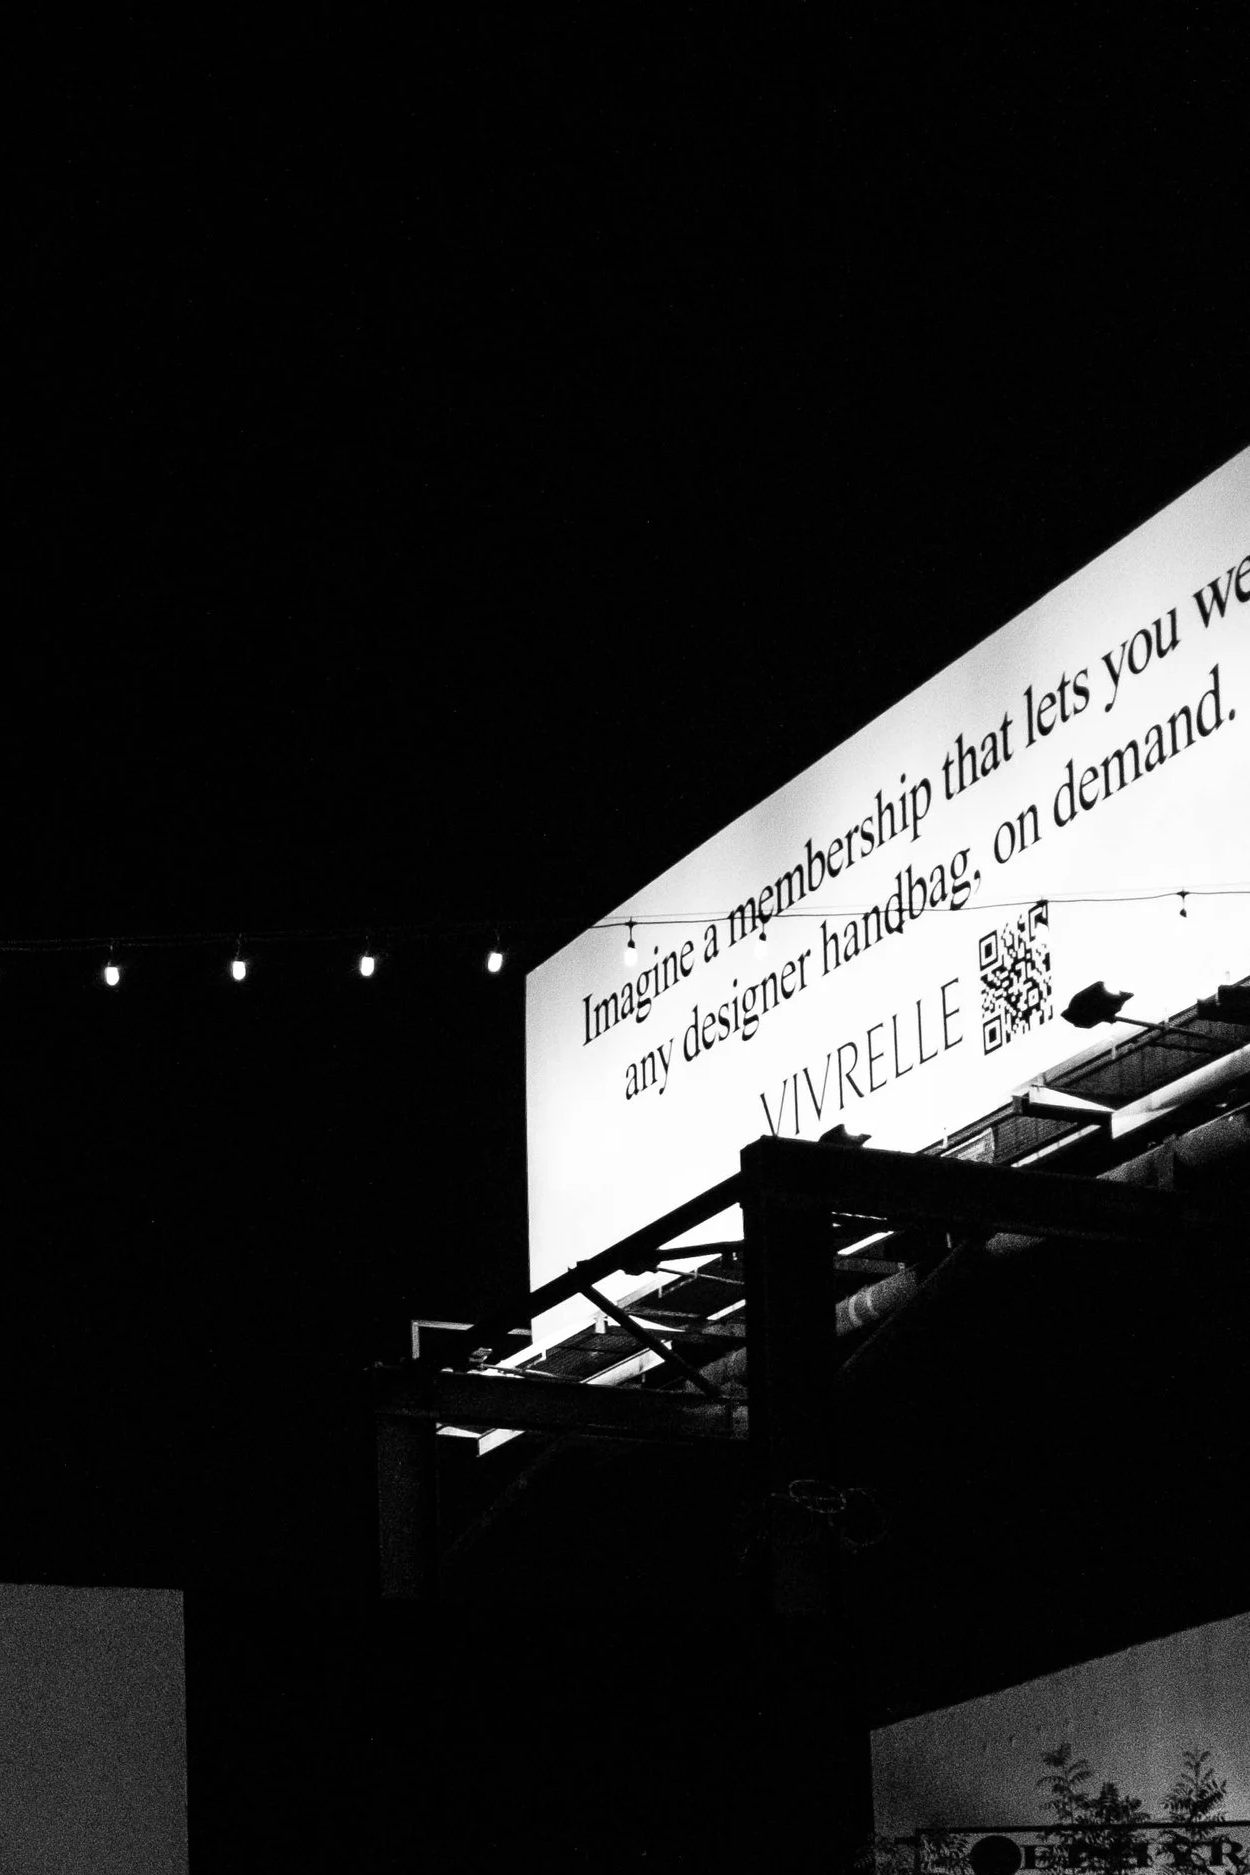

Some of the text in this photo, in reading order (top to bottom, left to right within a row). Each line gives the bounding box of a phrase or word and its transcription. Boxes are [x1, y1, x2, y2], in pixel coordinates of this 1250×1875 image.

[582, 940, 695, 1046] Imagine
[704, 924, 720, 963] a
[727, 773, 932, 948] membership
[942, 711, 1014, 801] that
[1023, 667, 1090, 748] lets
[1101, 607, 1181, 713] you
[625, 663, 1236, 1101] any designer handbag, on demand.
[760, 977, 964, 1136] VIVRELLE
